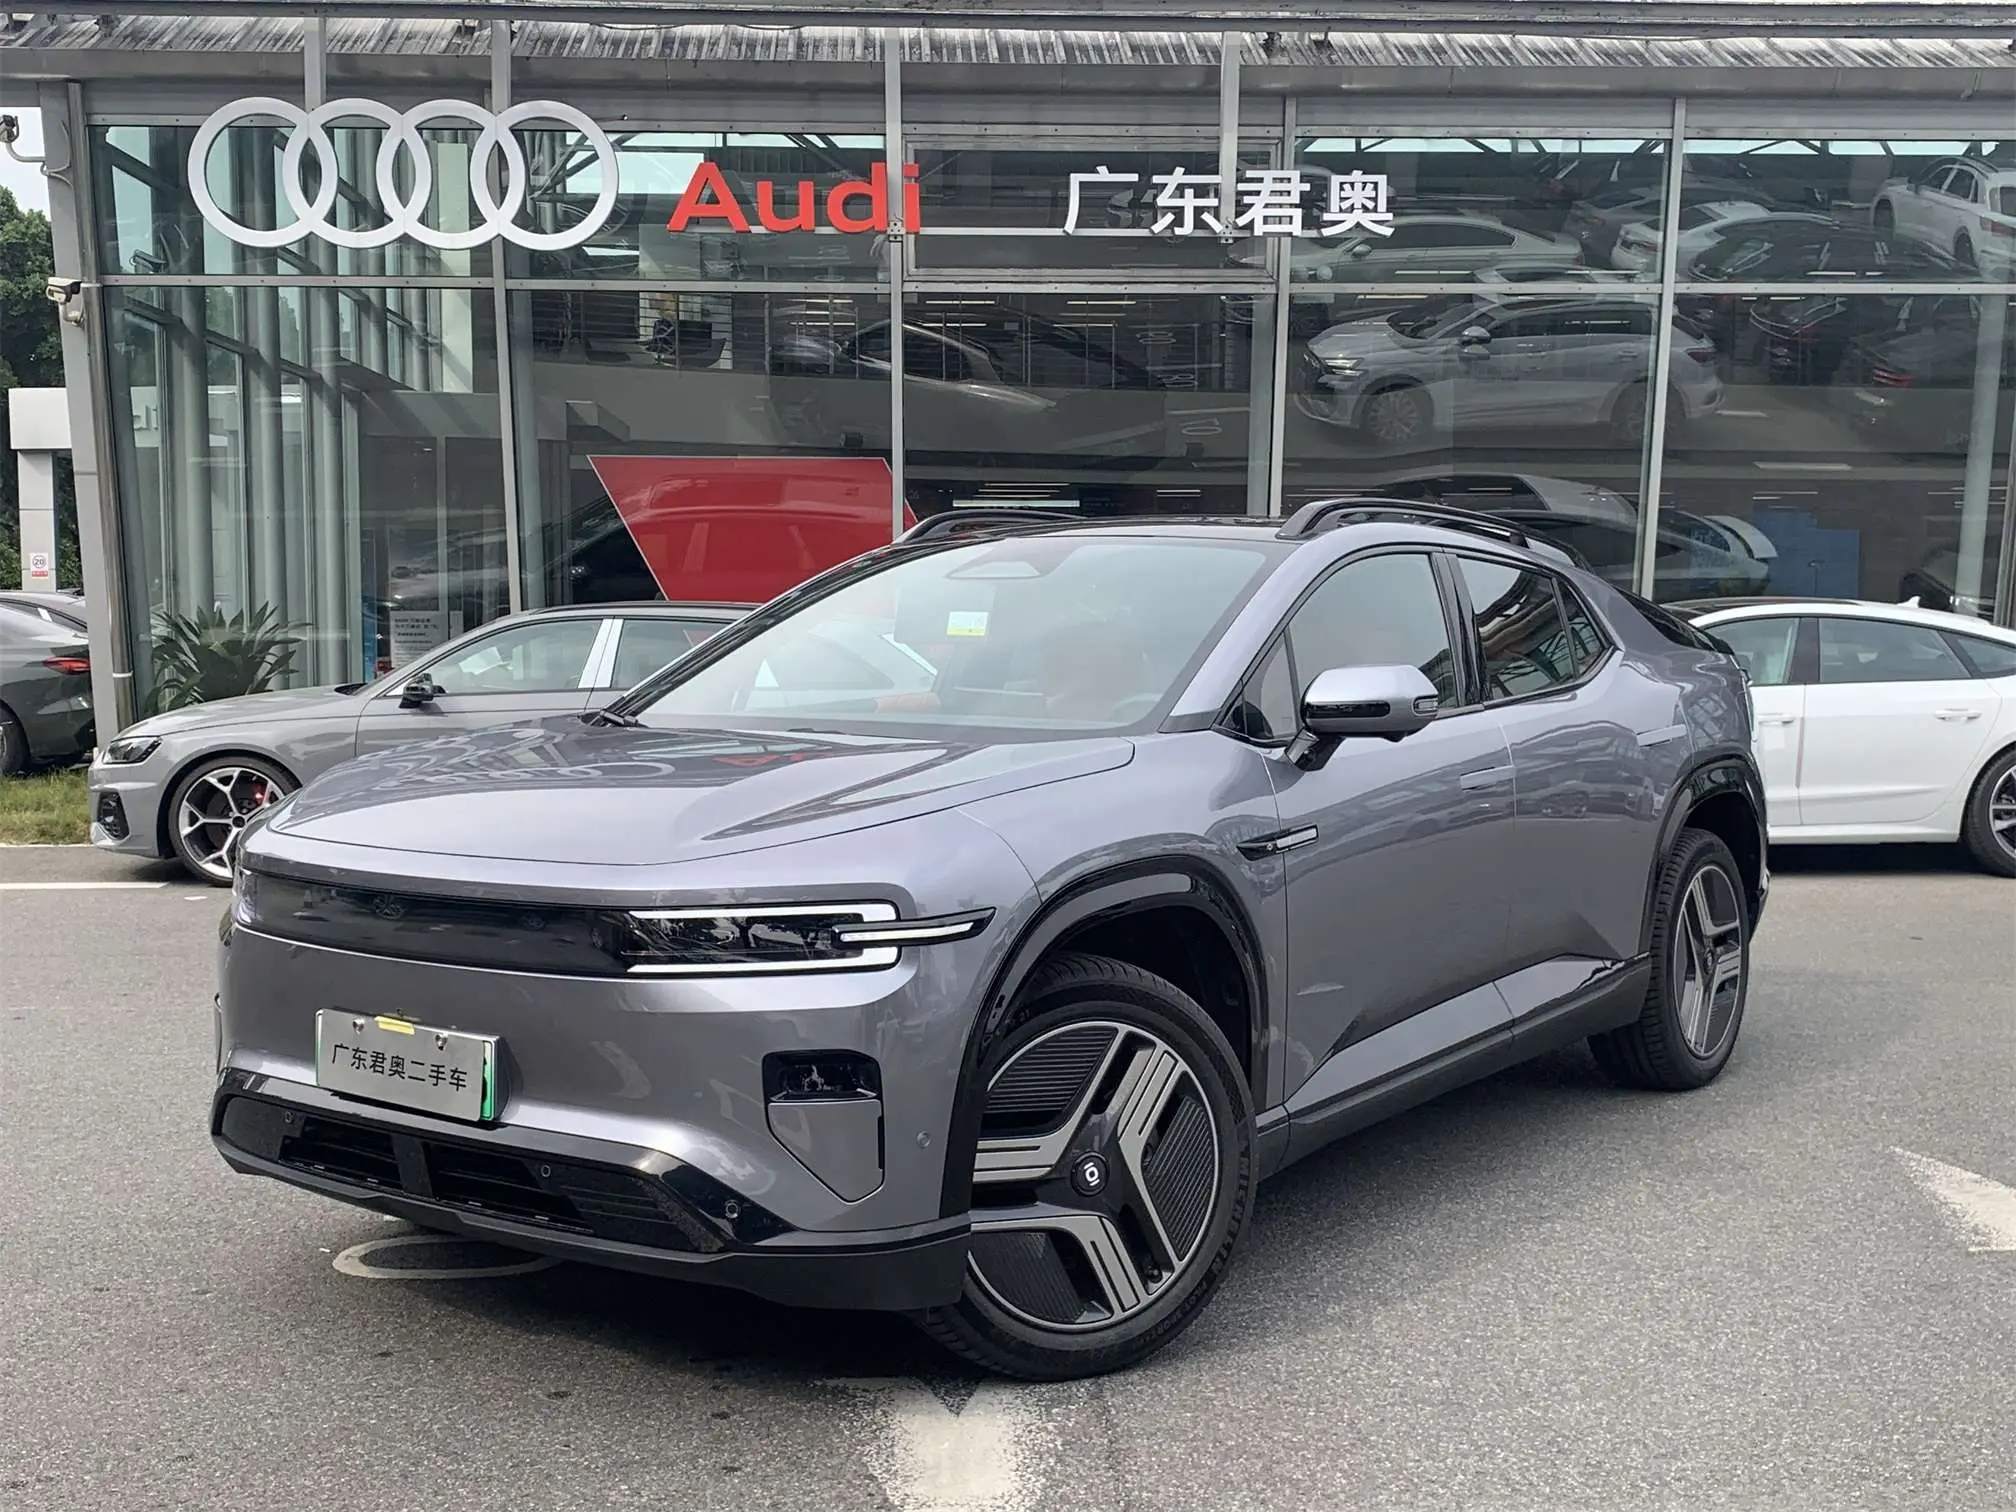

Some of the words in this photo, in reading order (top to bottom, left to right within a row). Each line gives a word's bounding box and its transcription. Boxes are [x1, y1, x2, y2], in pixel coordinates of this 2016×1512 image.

[667, 161, 921, 234] Audi
[1063, 165, 1396, 238] 广东君奥
[331, 1043, 468, 1092] 广东君奥二手车
